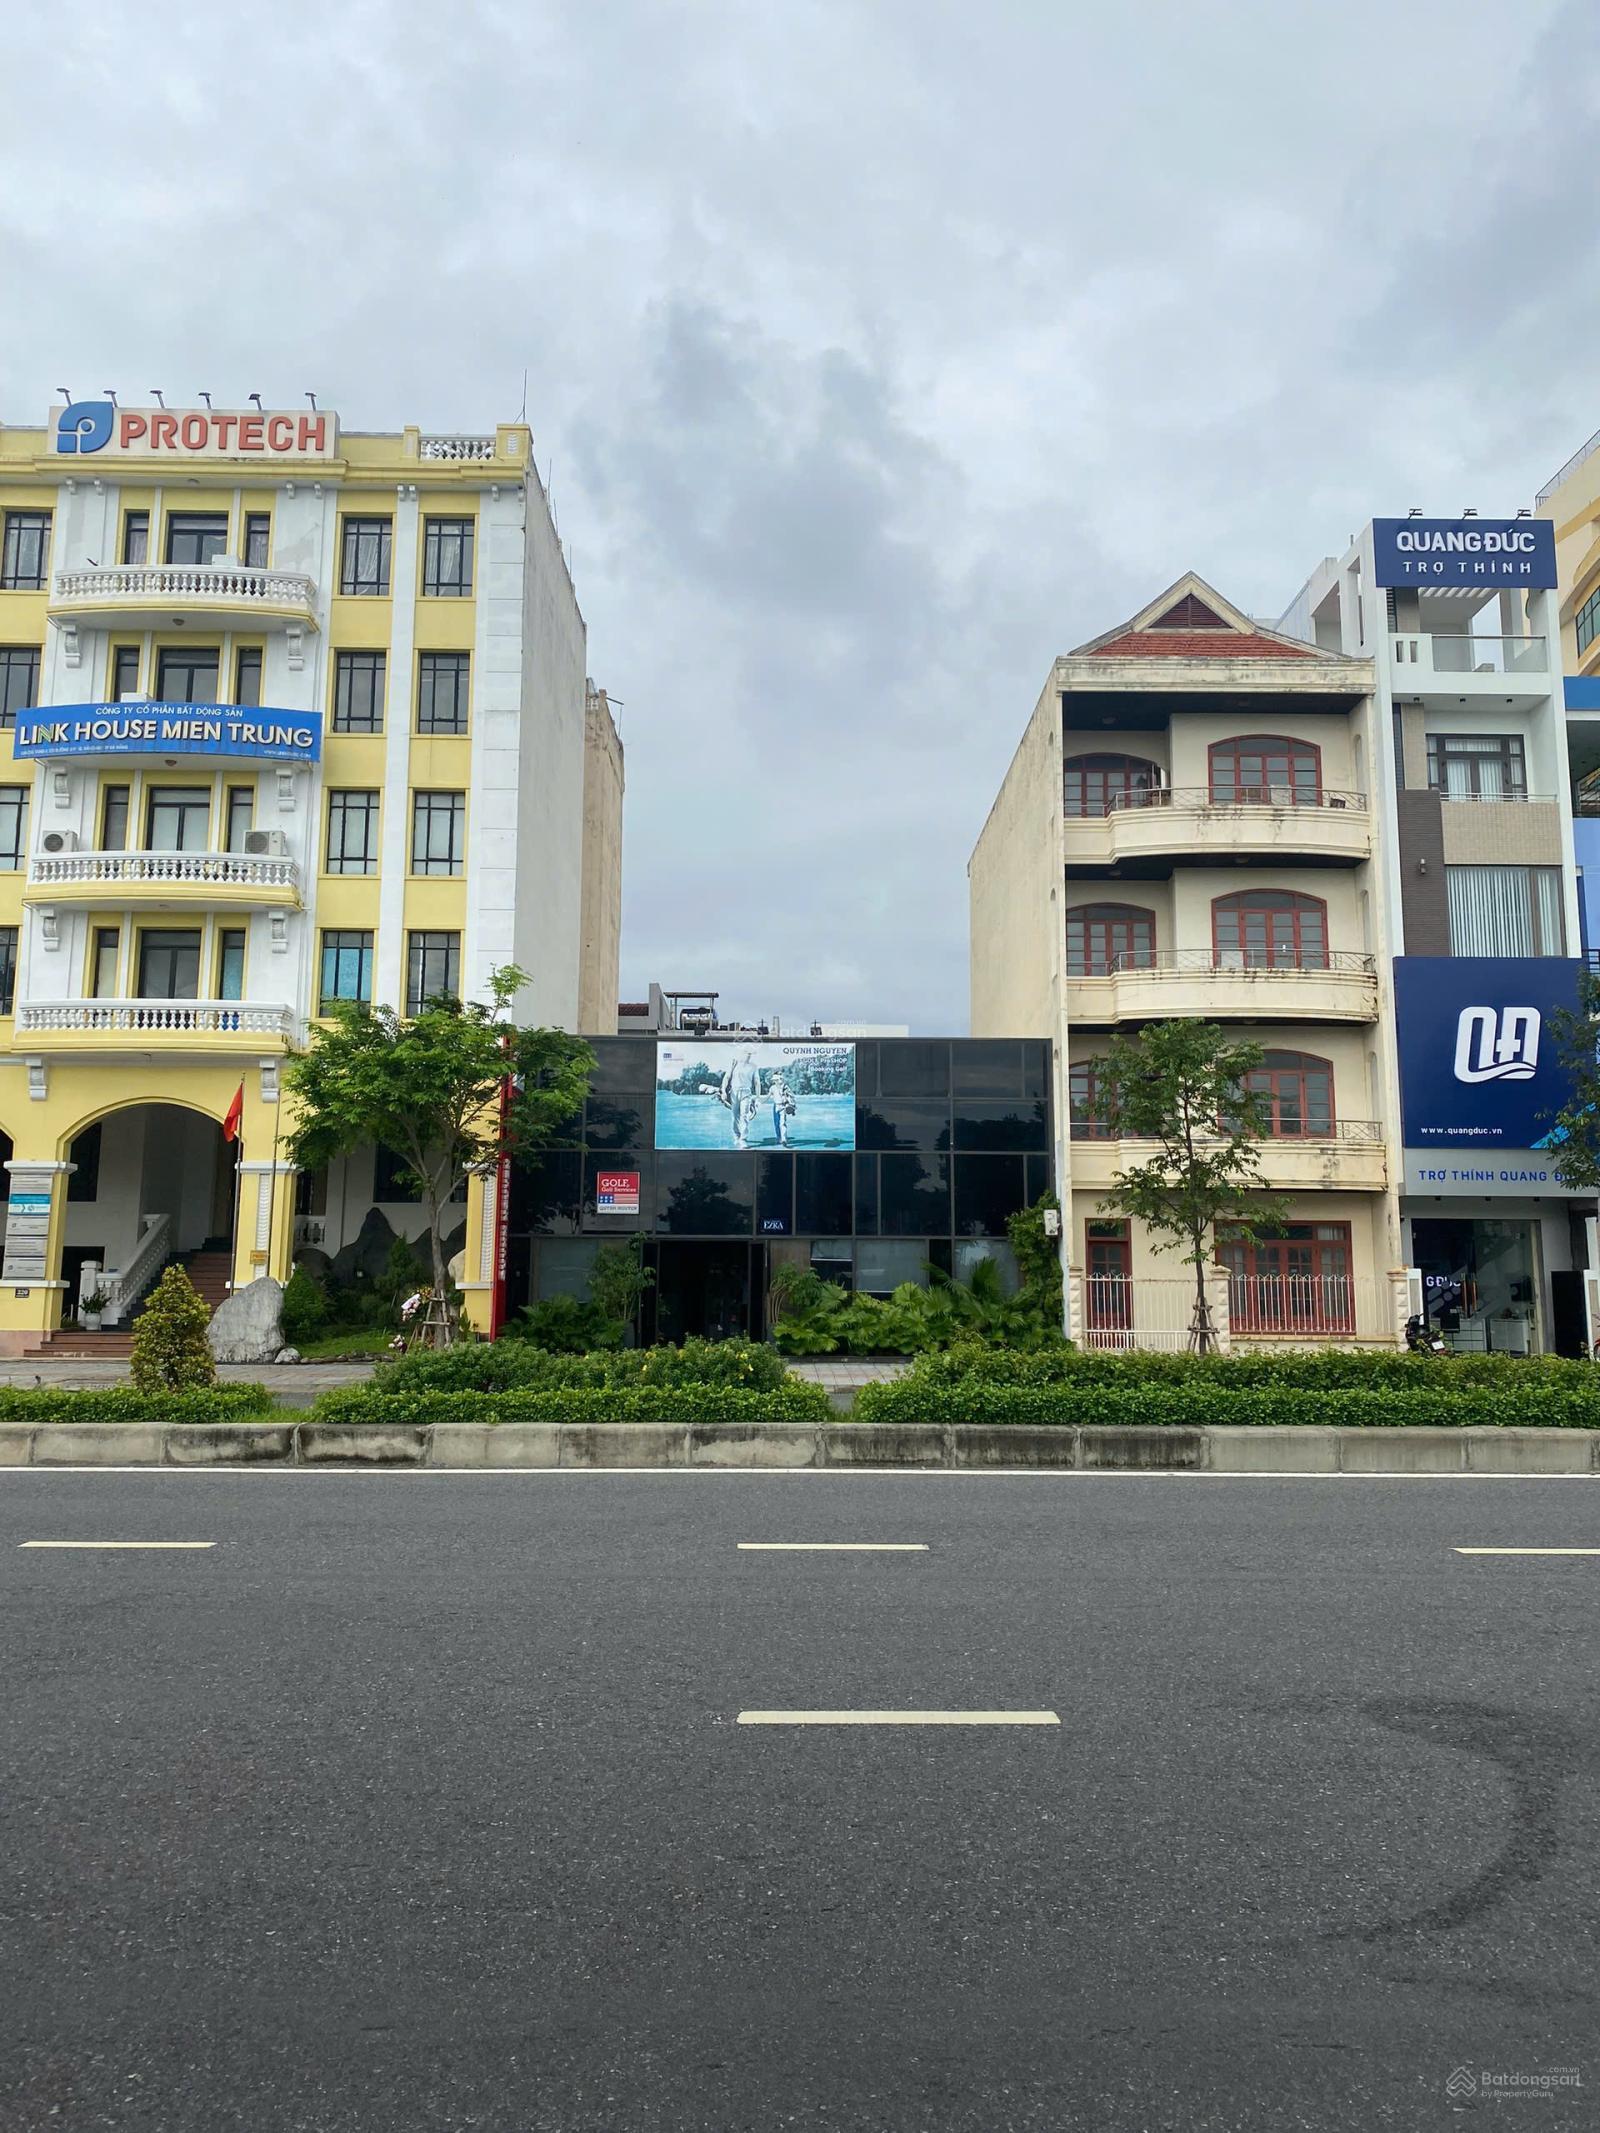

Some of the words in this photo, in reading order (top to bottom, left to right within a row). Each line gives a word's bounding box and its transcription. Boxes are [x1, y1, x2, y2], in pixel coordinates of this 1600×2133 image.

[120, 414, 325, 451] PROTECH
[1402, 561, 1444, 575] TRỢ
[1458, 560, 1531, 574] THÍNH
[96, 707, 121, 715] CÔNG
[124, 706, 136, 714] TY
[136, 704, 150, 714] CỔ
[177, 705, 193, 715] BẤT
[196, 707, 221, 717] ĐỘNG
[225, 707, 243, 717] SẢN
[19, 722, 70, 745] LINK
[74, 719, 157, 741] HOUSE
[161, 720, 222, 741] MIEN
[227, 722, 313, 748] TRUNG
[783, 1047, 811, 1055] QUYNH
[813, 1047, 847, 1055] NGUYEN
[1420, 1127, 1503, 1136] www.quangduc.vn
[1418, 1169, 1447, 1183] TRỢ
[1451, 1168, 1494, 1181] THÍNH
[1500, 1171, 1547, 1182] QUANG
